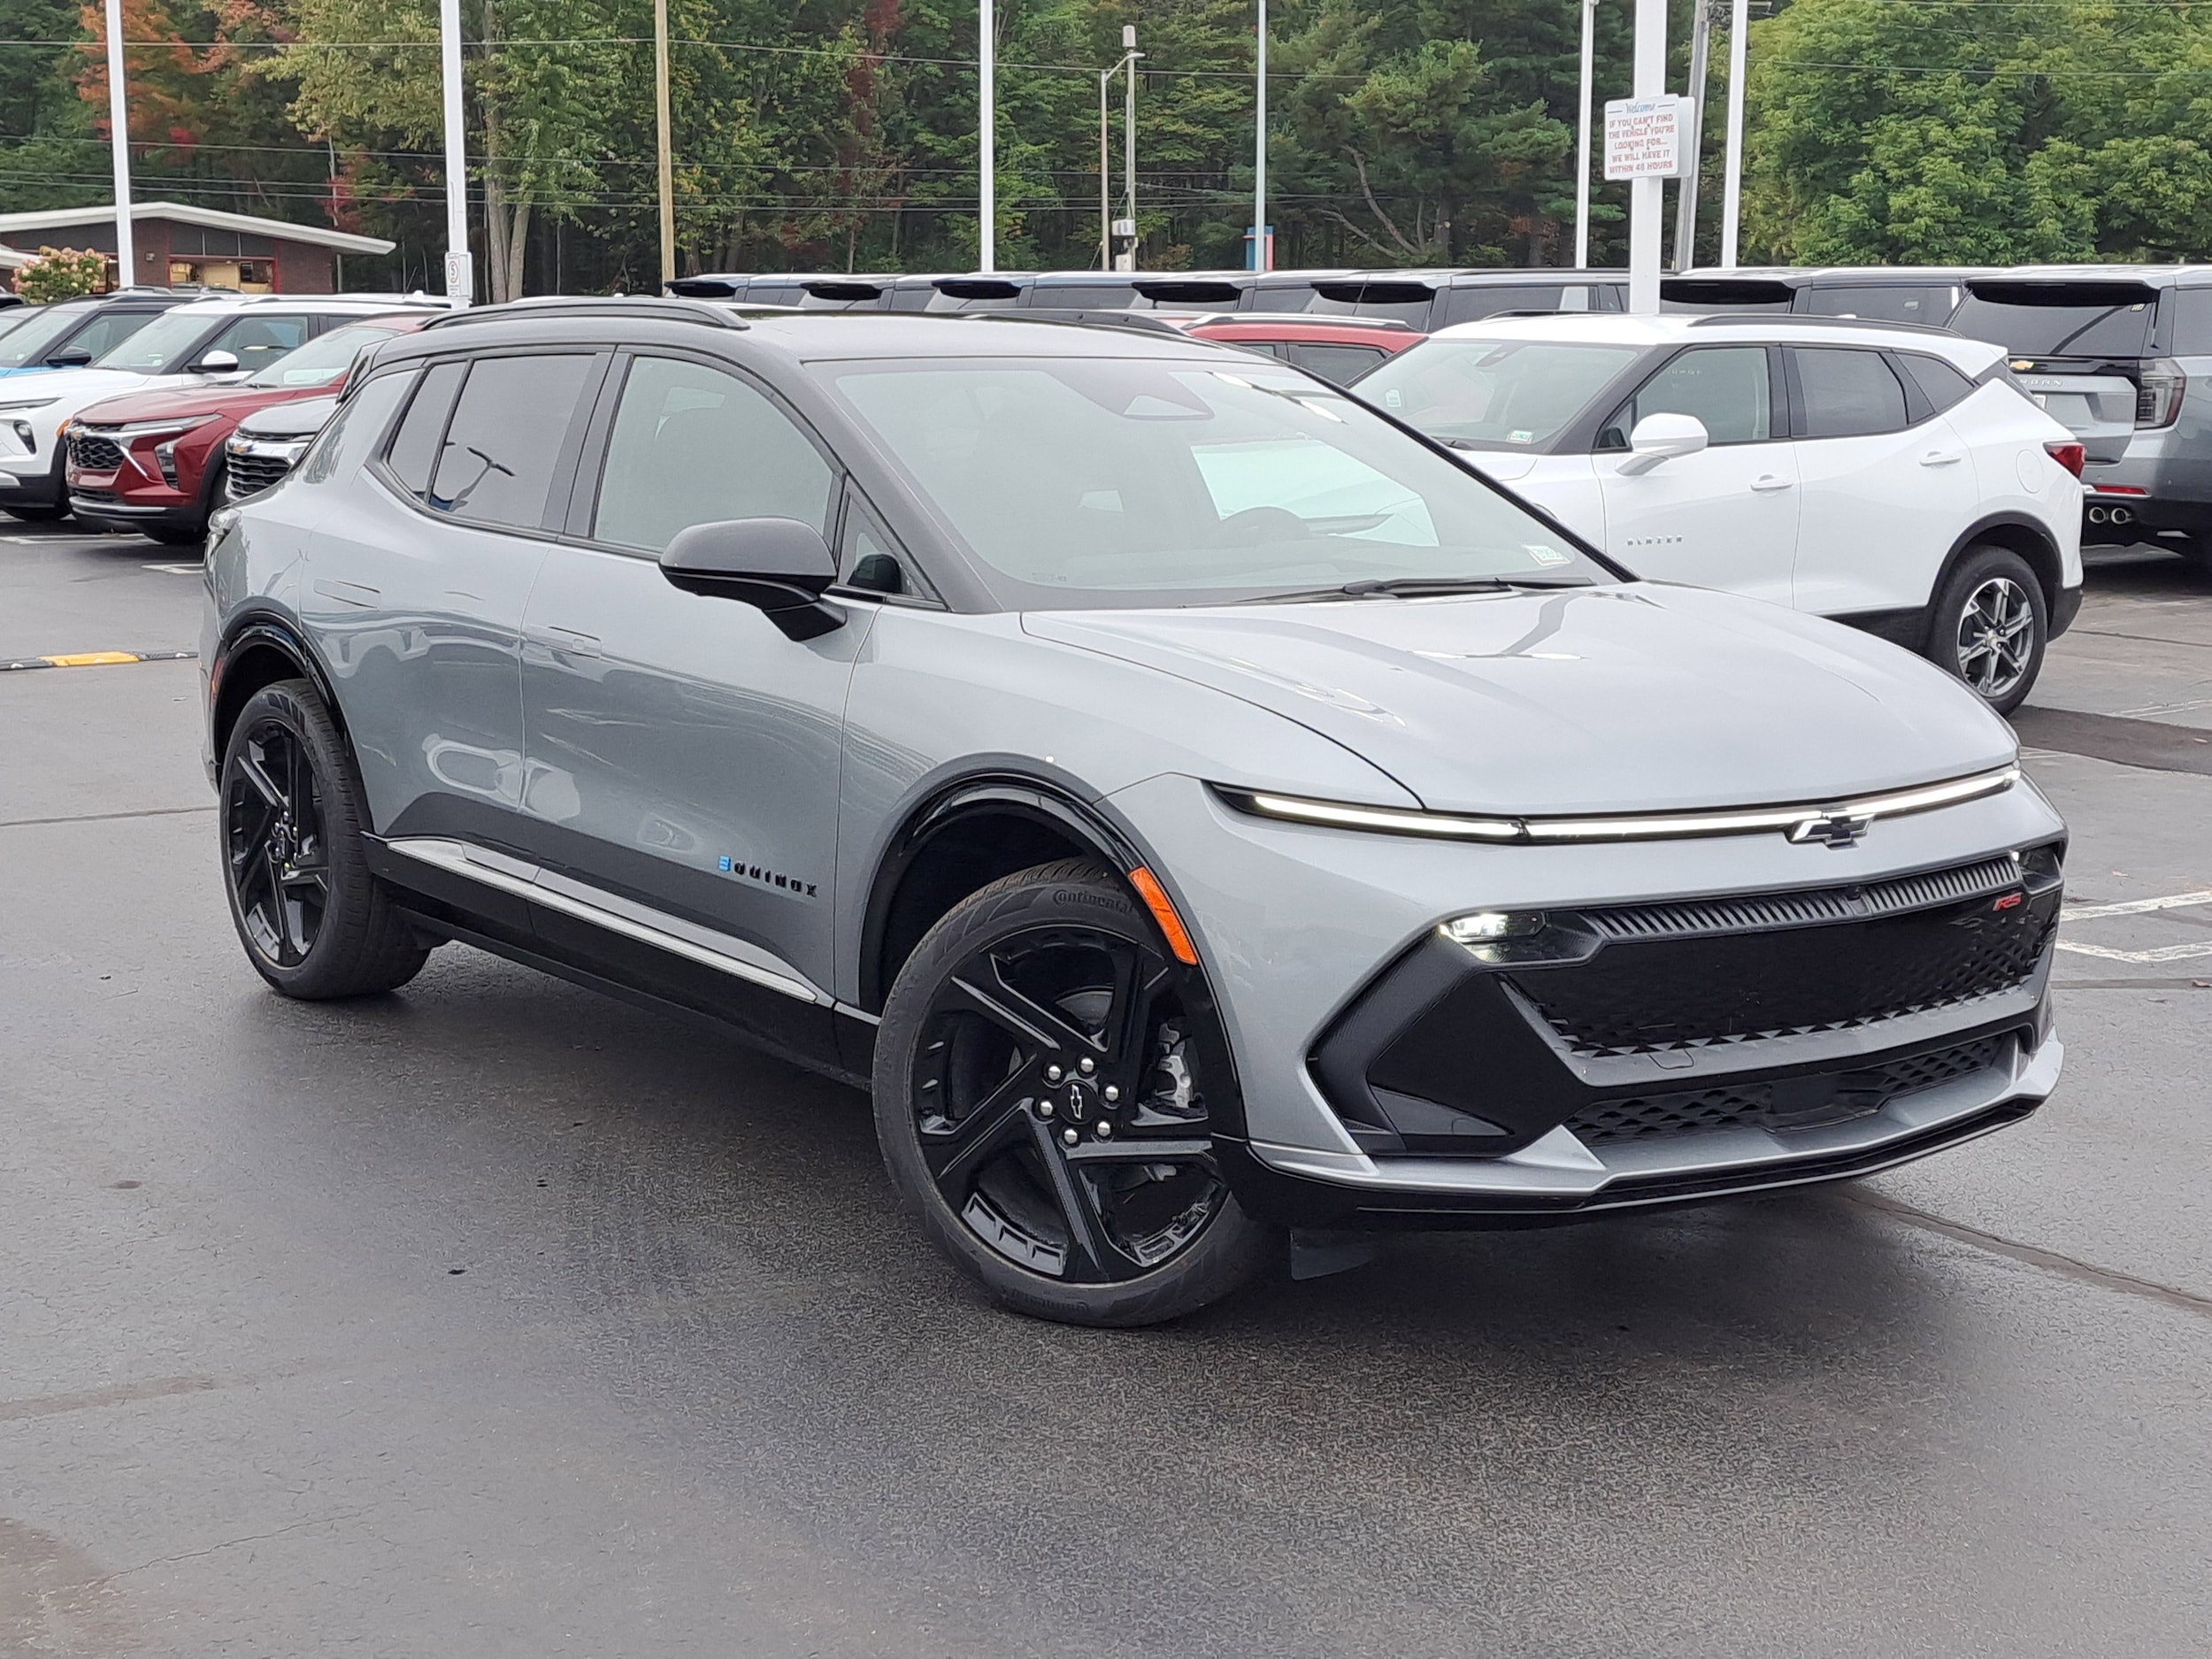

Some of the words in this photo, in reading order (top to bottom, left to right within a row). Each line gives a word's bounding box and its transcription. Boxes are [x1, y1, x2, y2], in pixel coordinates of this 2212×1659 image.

[1617, 119, 1632, 127] YOU
[1633, 116, 1655, 125] CAN'T
[1622, 128, 1648, 138] VEHICLE
[1650, 125, 1675, 135] YOU'RE
[1615, 140, 1644, 150] LOOKING
[1612, 154, 1622, 163] WE
[1642, 150, 1661, 159] HAVE
[1609, 165, 1633, 173] WITHIN
[1647, 160, 1673, 170] HOURS
[1627, 534, 1683, 546] BLAZER
[718, 855, 818, 898] EQUINOX
[1053, 889, 1133, 914] Continental
[1993, 892, 2023, 911] RS
